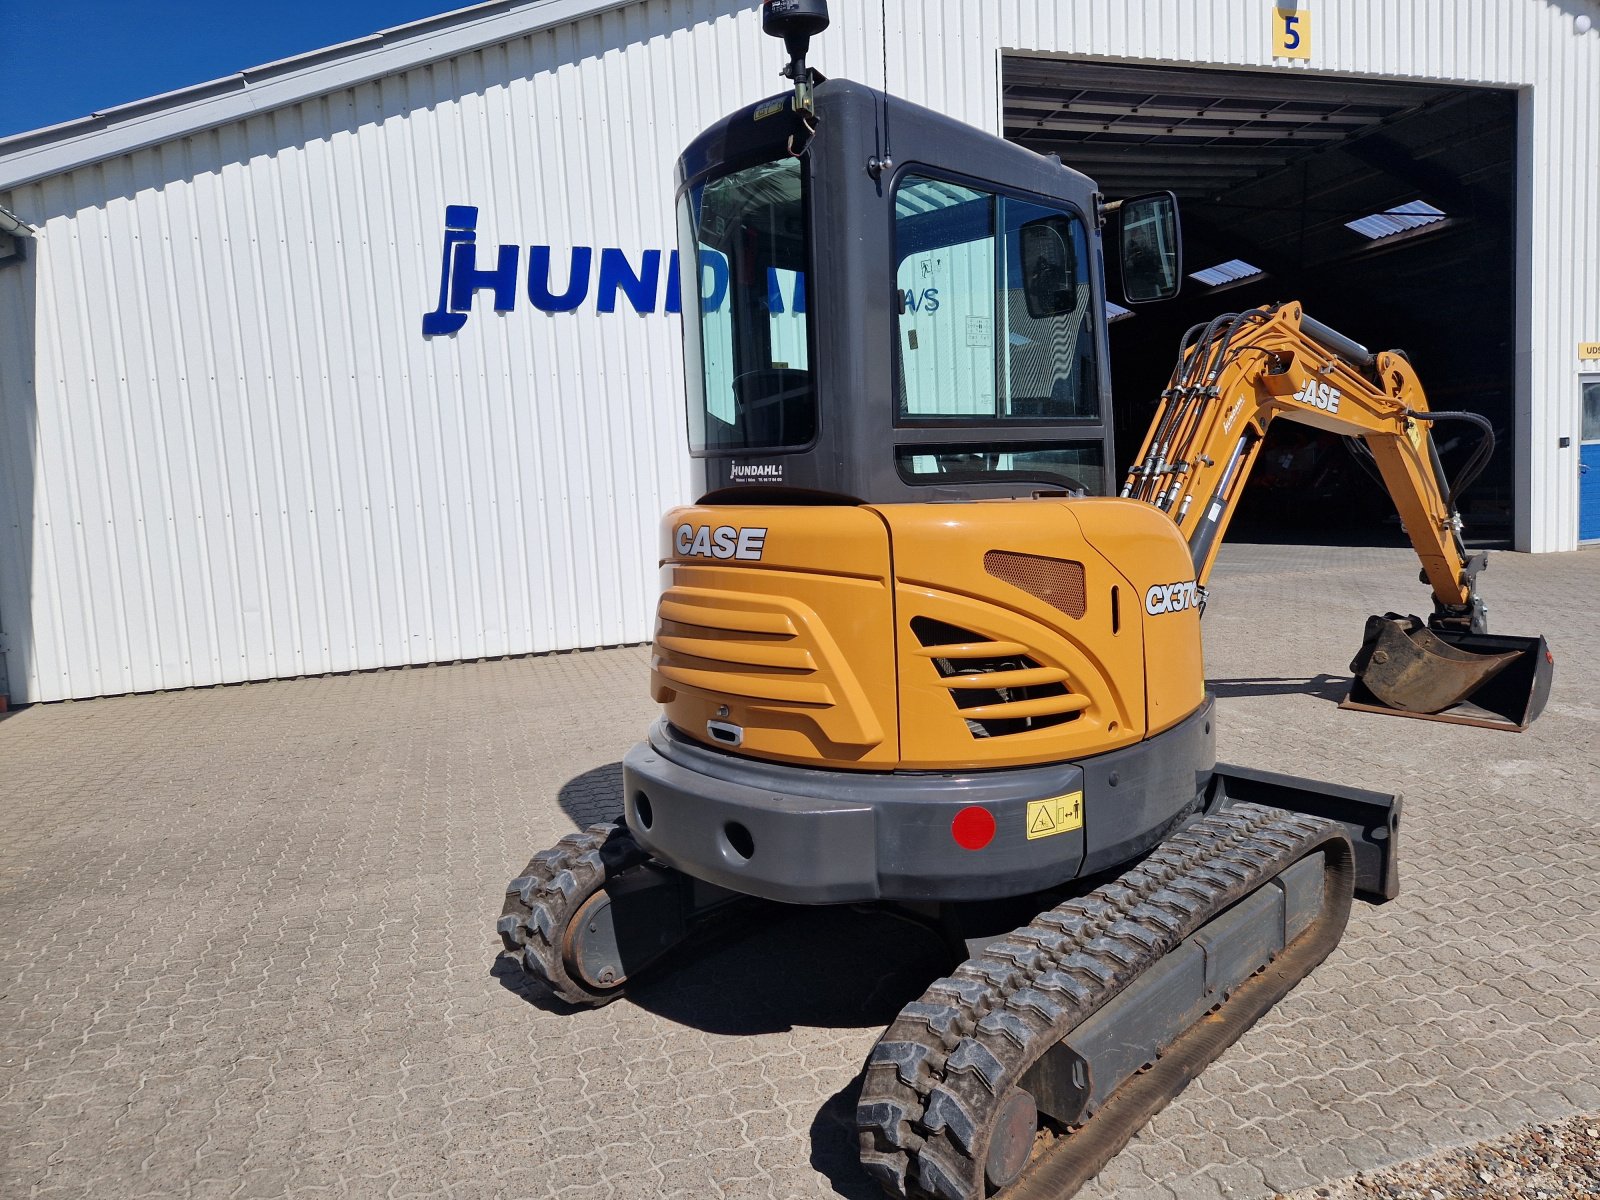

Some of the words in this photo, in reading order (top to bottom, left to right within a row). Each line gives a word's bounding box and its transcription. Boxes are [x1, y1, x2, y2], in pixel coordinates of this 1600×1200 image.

[1284, 16, 1300, 50] 5
[904, 288, 940, 312] A/S
[676, 523, 768, 561] CASE
